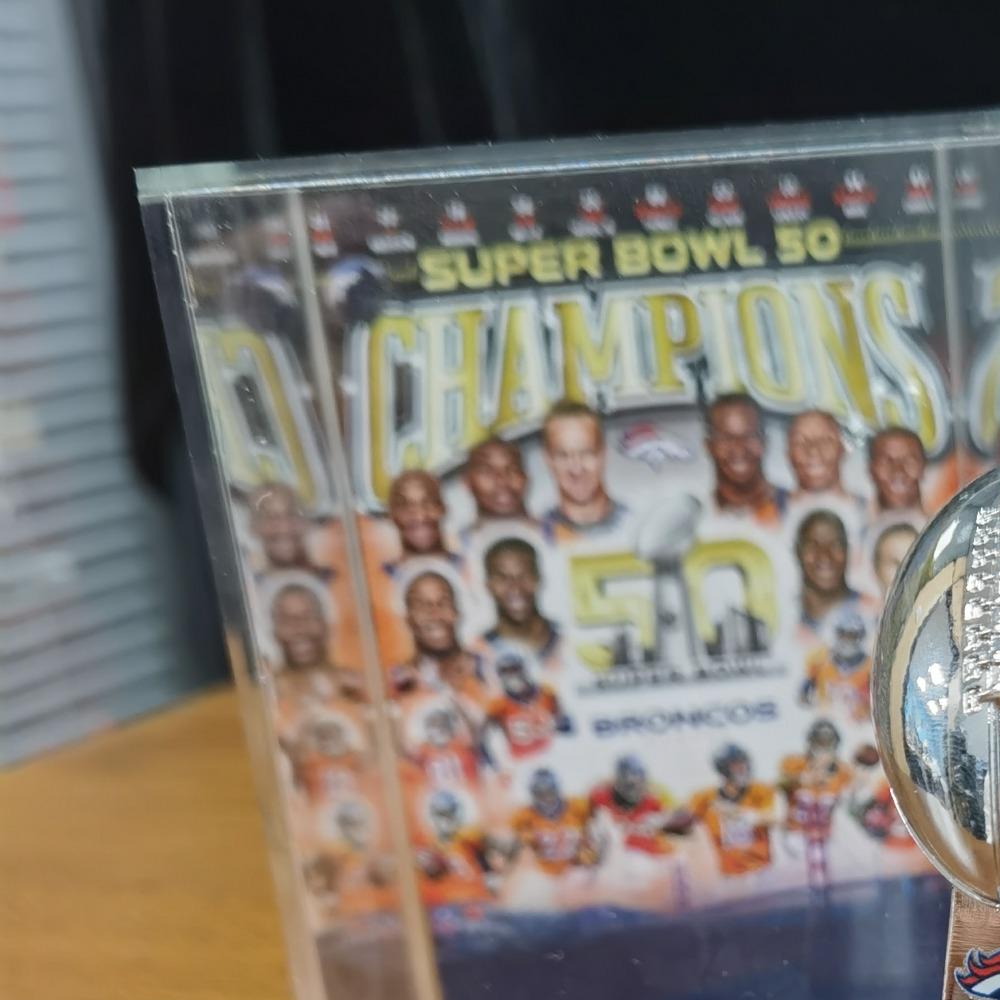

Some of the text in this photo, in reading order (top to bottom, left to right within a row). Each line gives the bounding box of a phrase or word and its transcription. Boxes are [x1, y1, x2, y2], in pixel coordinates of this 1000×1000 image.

[417, 217, 841, 293] SUPER BOWL 50
[352, 266, 948, 510] CHAMPIONS
